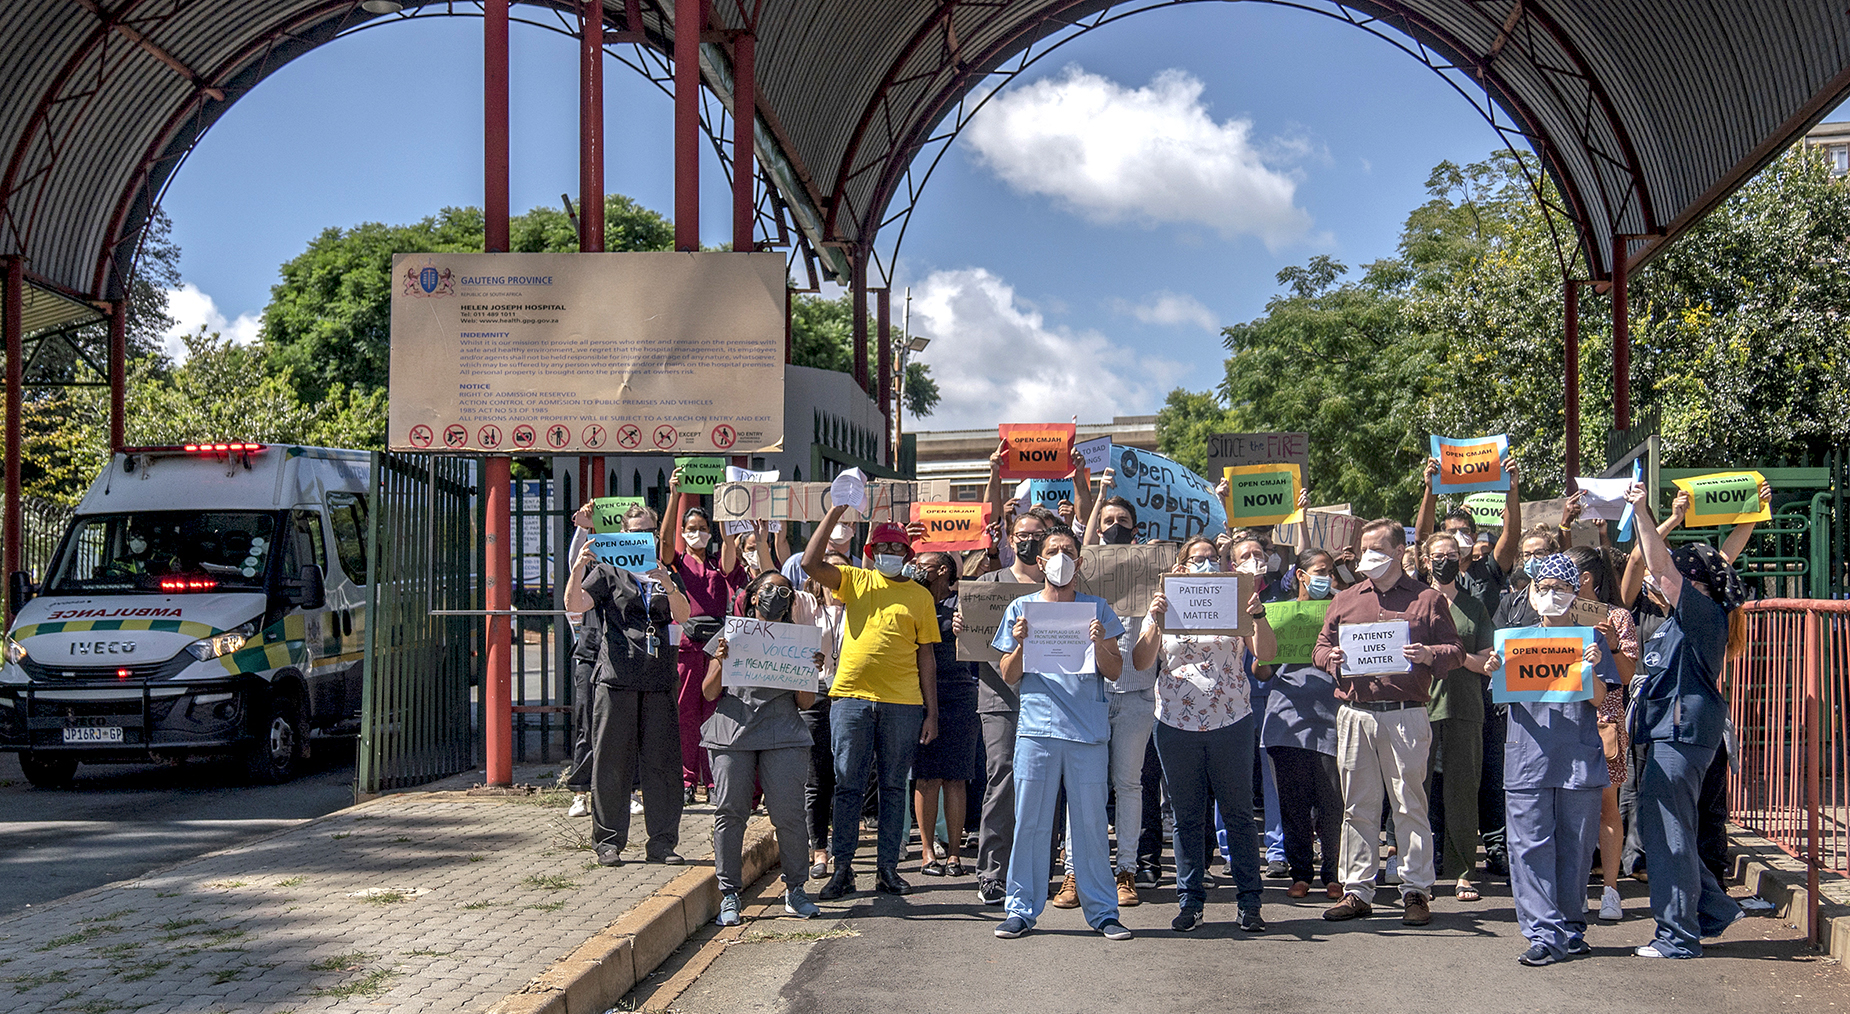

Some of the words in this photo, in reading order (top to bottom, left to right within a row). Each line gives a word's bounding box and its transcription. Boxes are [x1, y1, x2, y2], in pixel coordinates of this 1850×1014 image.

[460, 276, 505, 284] GAUTENG
[507, 276, 553, 284] PROVINCE
[1250, 441, 1264, 452] the
[1267, 435, 1304, 458] FIRE
[1019, 450, 1057, 462] NOW
[1121, 450, 1175, 489] Open
[1452, 461, 1490, 474] NOW
[685, 475, 718, 485] NOW
[723, 485, 808, 519] OPEN
[1036, 490, 1070, 501] NOW
[1244, 493, 1283, 507] NOW
[1706, 490, 1747, 504] NOW
[1136, 483, 1210, 528] Joburg
[1469, 507, 1502, 517] NOW
[602, 513, 622, 527] NO
[931, 519, 971, 532] NOW
[601, 554, 644, 567] NOW
[1180, 586, 1222, 594] PATIENTS'
[1183, 611, 1218, 619] MATTER
[1582, 603, 1599, 614] CRY
[727, 618, 775, 640] SPEAK
[1353, 631, 1395, 641] PATIENTS'
[70, 641, 136, 655] IVECO
[1364, 644, 1386, 652] LIVES
[1358, 656, 1393, 665] MATTER
[1519, 663, 1570, 679] NOW
[65, 729, 101, 740] JP16RJ
[109, 729, 122, 740] GP
